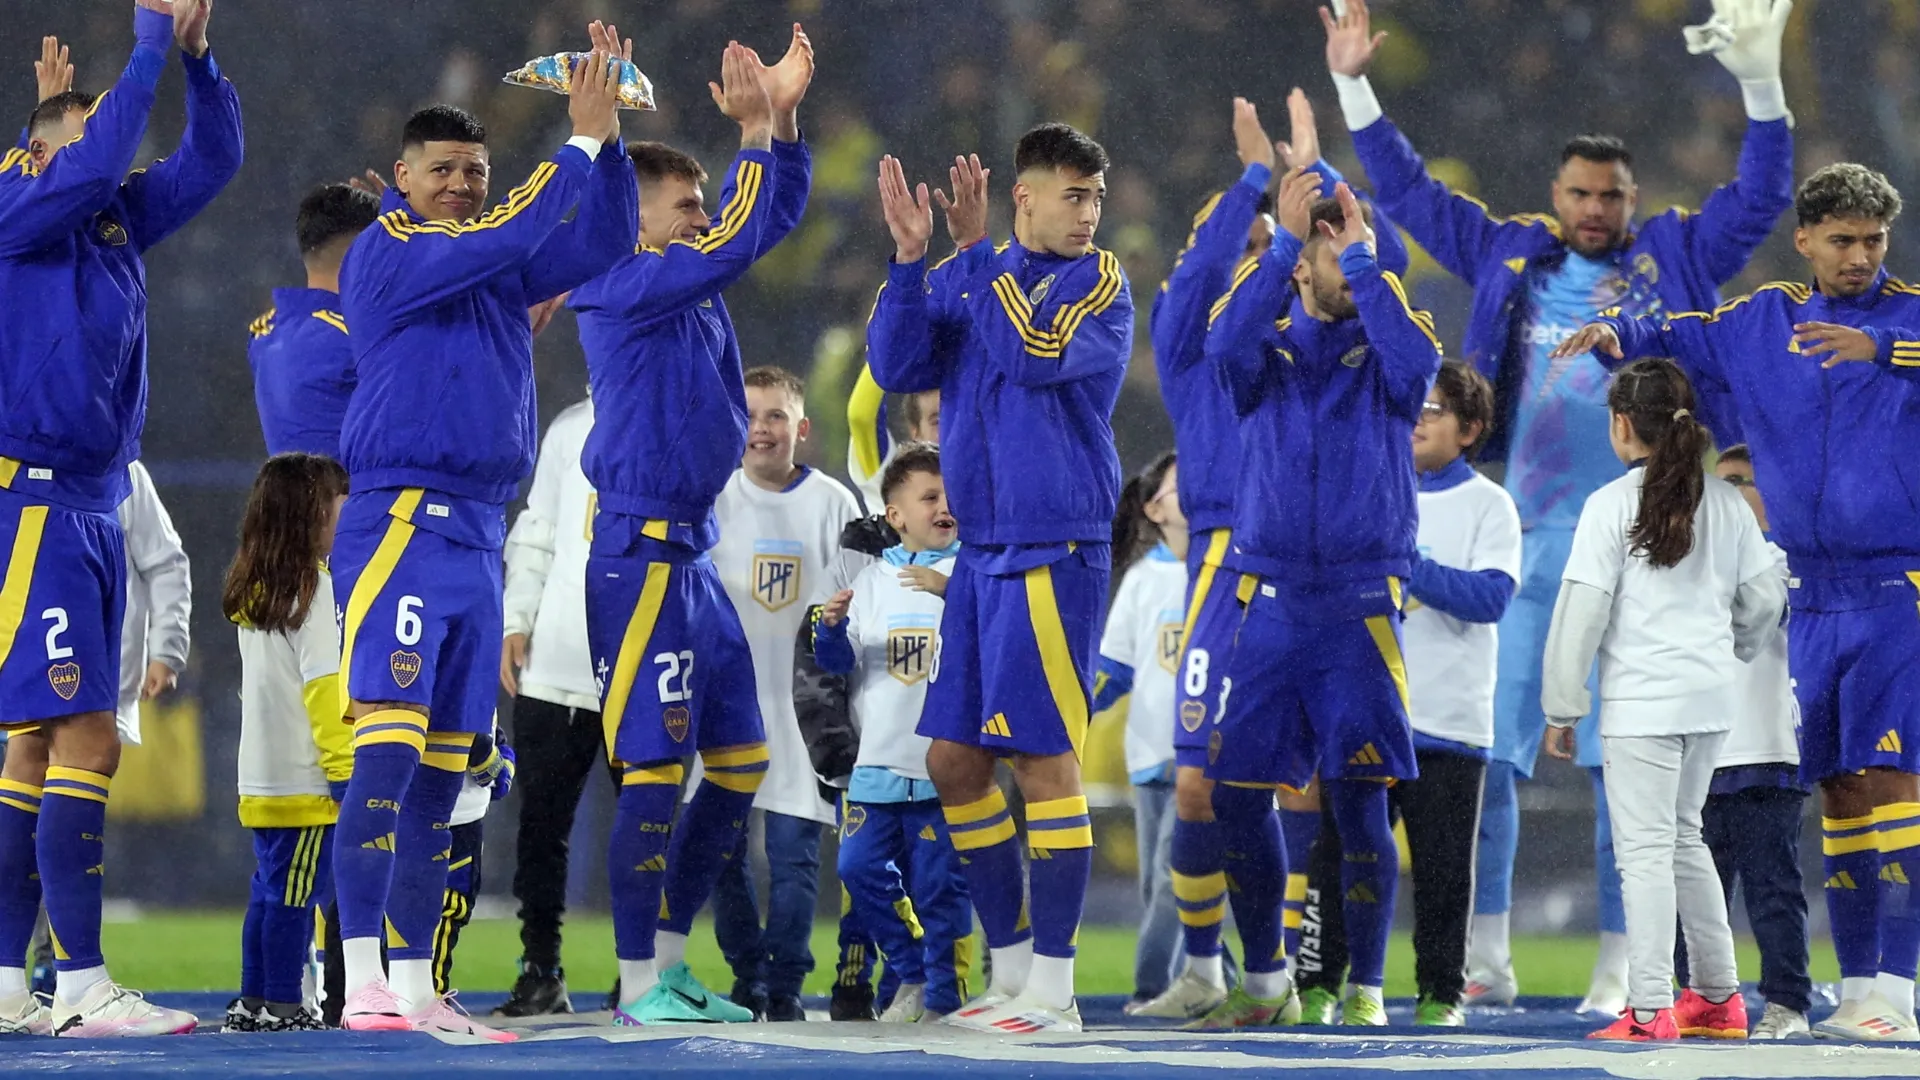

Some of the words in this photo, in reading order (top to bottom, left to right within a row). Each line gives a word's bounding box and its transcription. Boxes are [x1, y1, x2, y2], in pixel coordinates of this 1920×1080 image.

[758, 561, 793, 603] LPF
[41, 607, 73, 660] 2
[395, 595, 424, 646] 6
[393, 662, 416, 672] CABJ
[654, 650, 694, 703] 22
[893, 635, 928, 675] LPF
[1184, 647, 1210, 697] 8
[53, 674, 77, 684] CABJ
